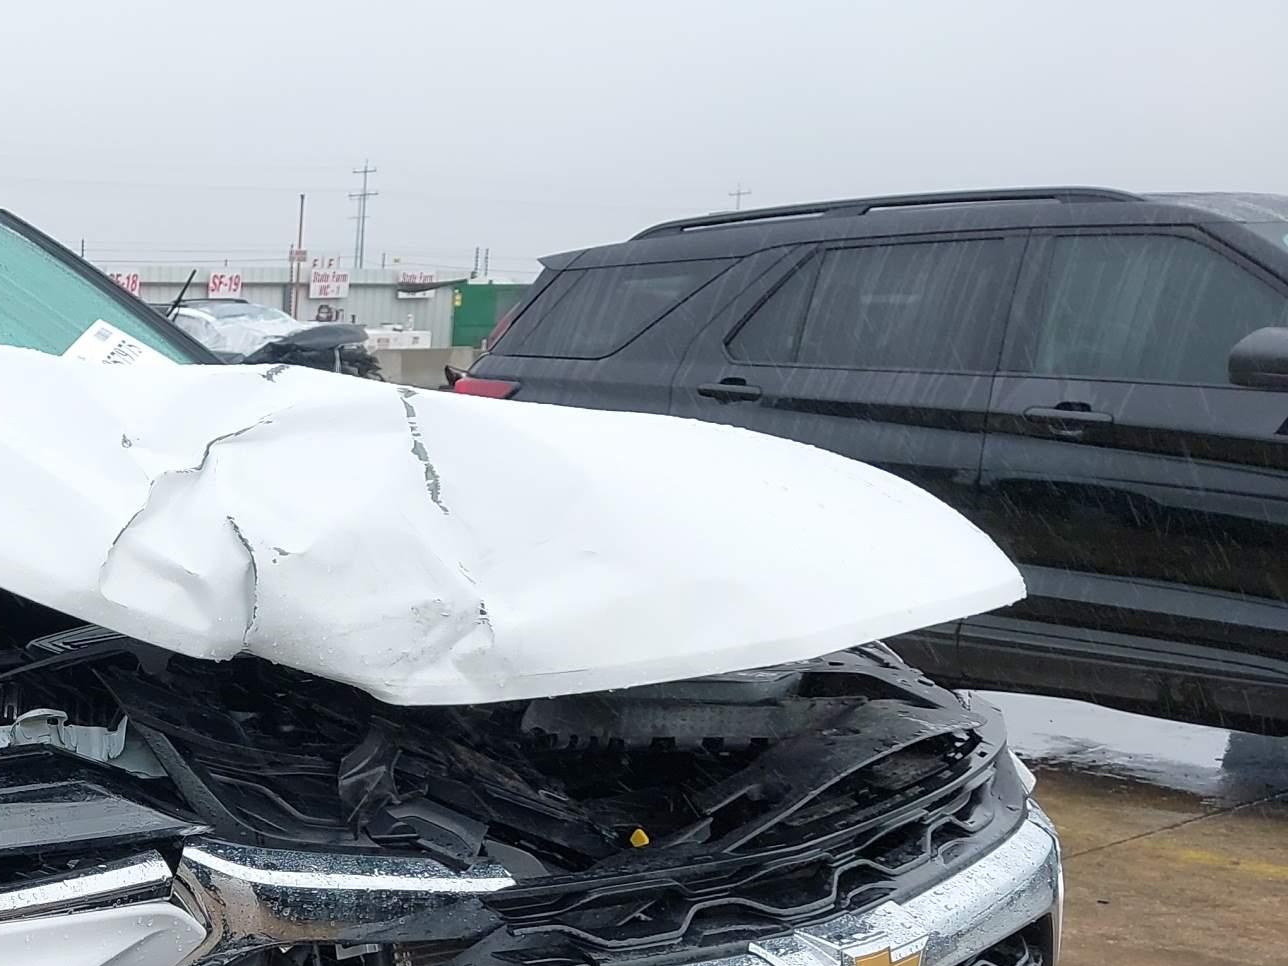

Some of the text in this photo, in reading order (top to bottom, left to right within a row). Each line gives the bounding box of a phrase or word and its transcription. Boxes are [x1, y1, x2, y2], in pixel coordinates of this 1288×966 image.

[210, 273, 241, 293] SF-19
[312, 271, 349, 283] State Farm
